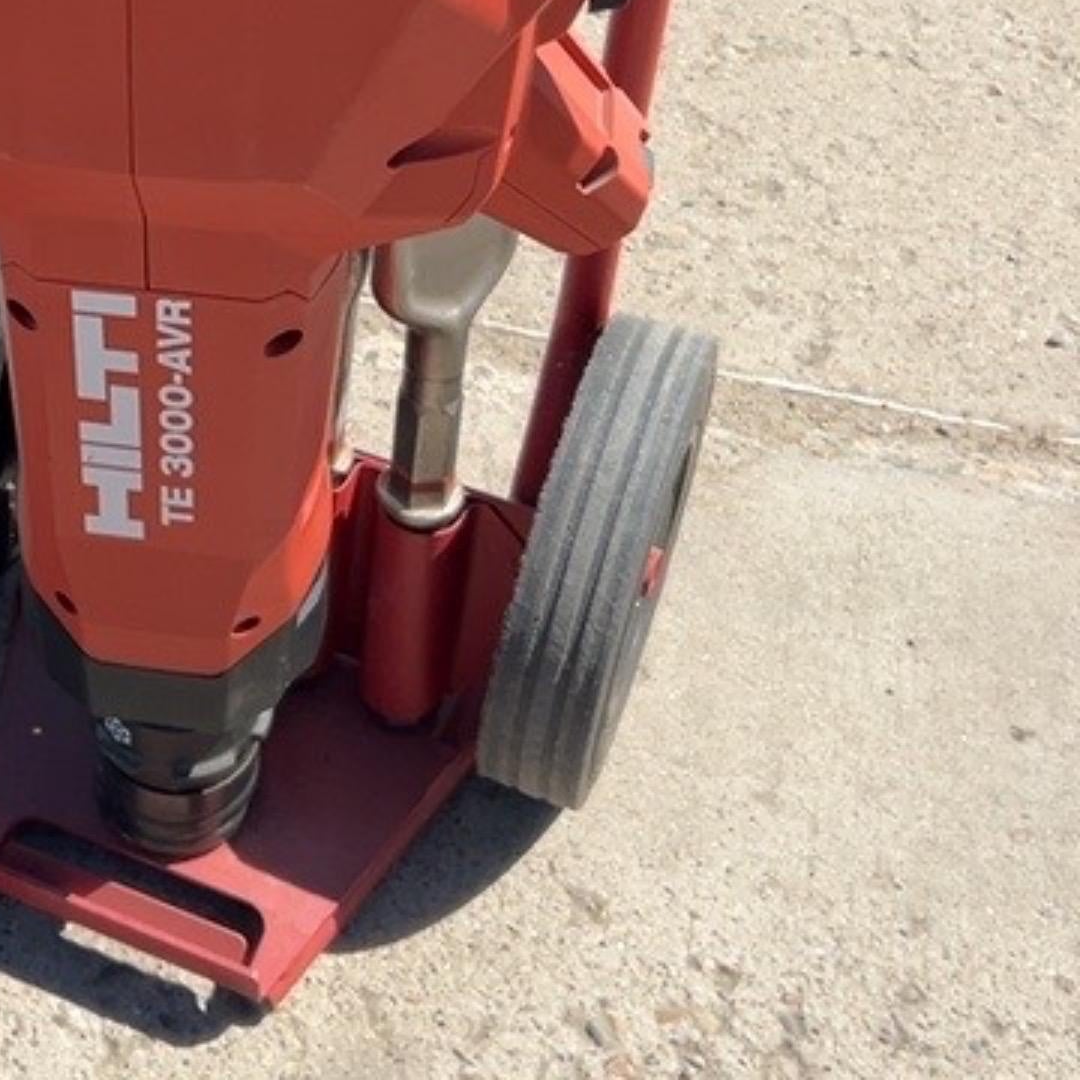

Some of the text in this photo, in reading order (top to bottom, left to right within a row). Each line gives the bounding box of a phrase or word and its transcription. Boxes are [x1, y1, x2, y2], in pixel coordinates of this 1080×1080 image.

[71, 289, 145, 540] HILTI
[156, 298, 195, 526] TE 3000-AVR
